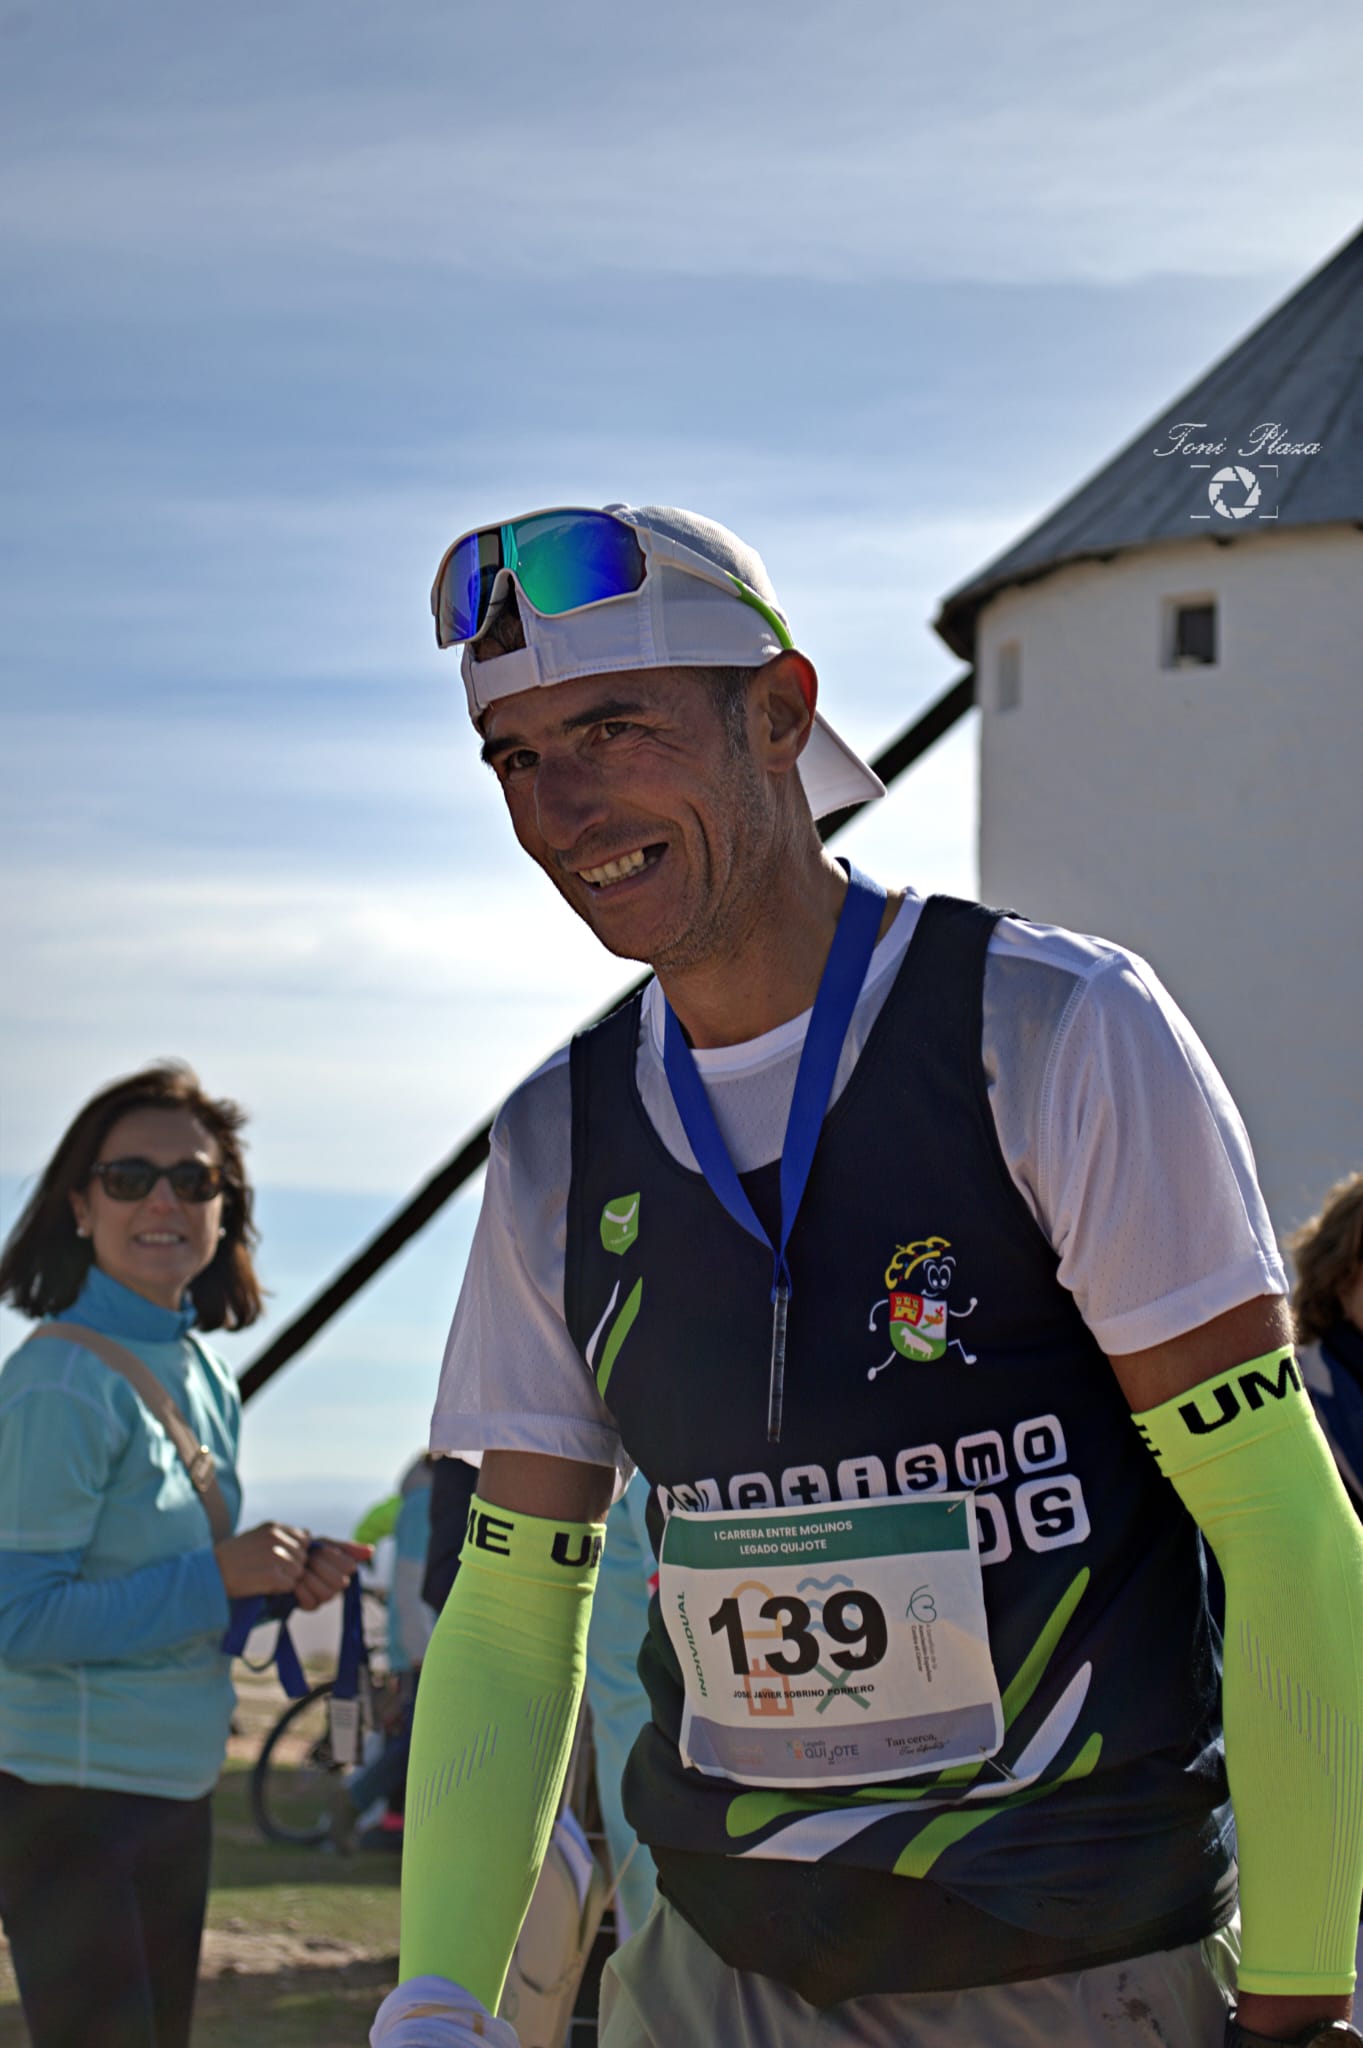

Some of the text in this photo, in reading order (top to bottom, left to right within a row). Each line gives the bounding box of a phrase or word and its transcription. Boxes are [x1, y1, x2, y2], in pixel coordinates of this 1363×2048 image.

[719, 1528, 765, 1541] CARRERA
[766, 1526, 797, 1538] ENTRE
[799, 1520, 853, 1535] MOLINOS
[740, 1539, 827, 1555] LEGADO QUIJOTE
[708, 1590, 888, 1676] 139
[677, 1591, 708, 1697] INDIVIDUAL
[754, 1690, 783, 1699] JAVIER
[784, 1688, 825, 1699] SOBRINO
